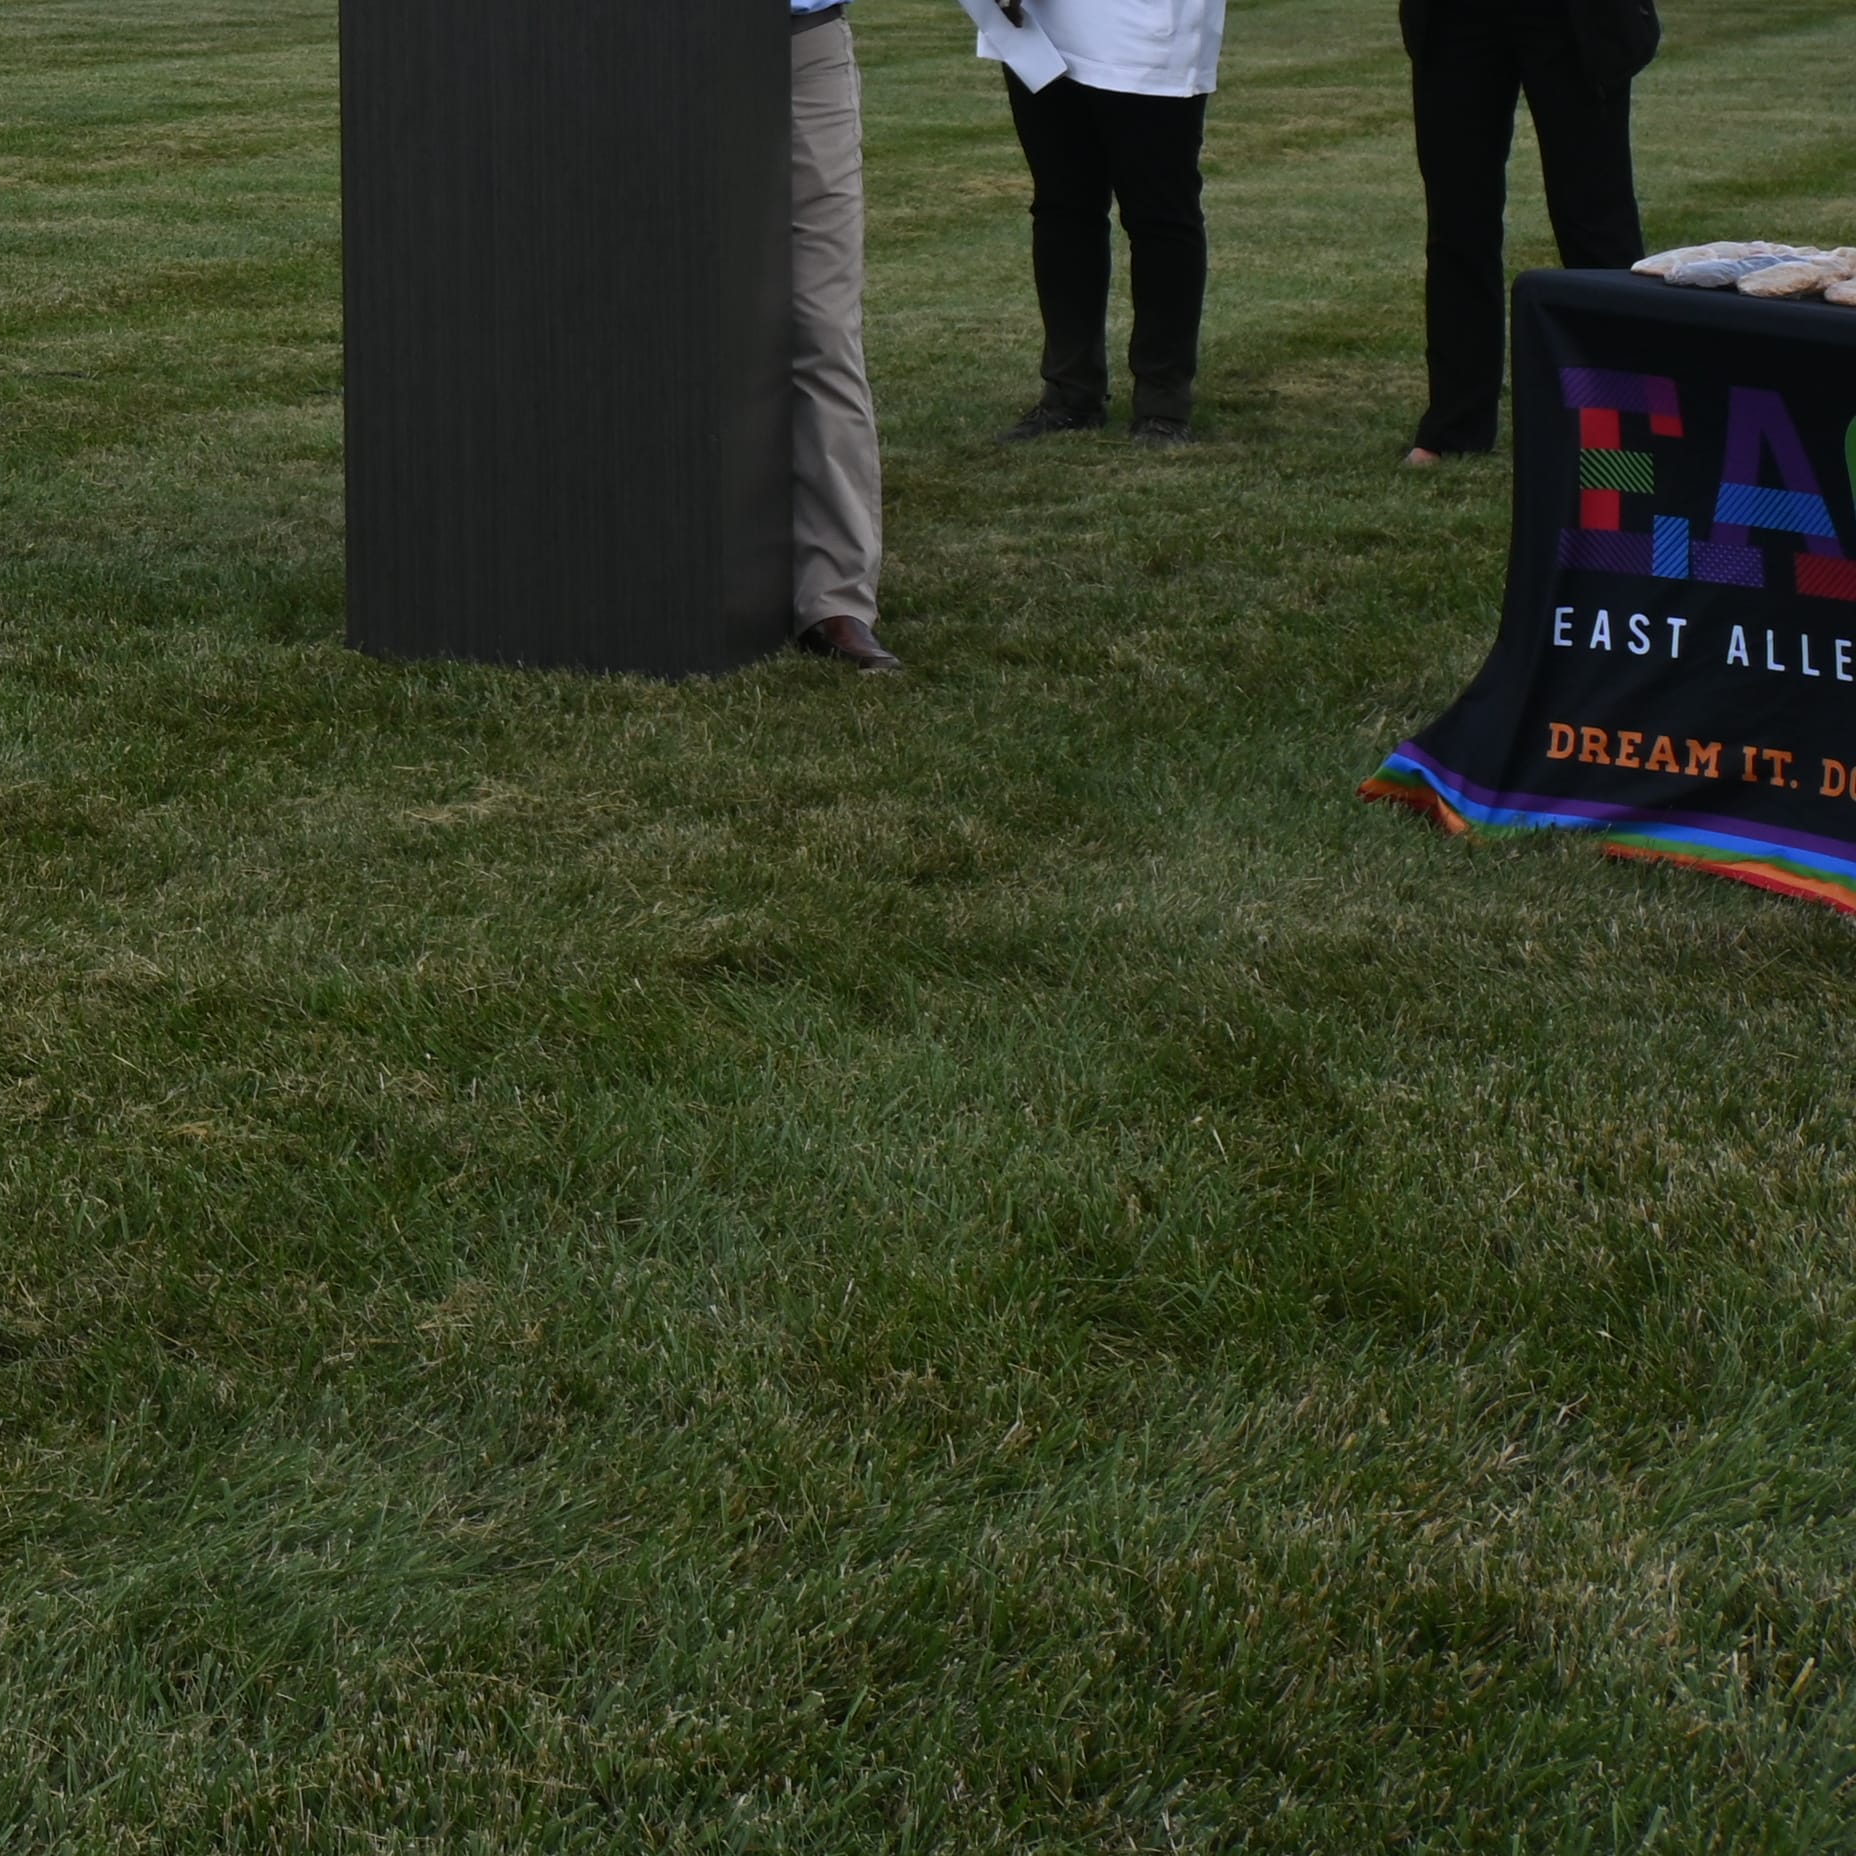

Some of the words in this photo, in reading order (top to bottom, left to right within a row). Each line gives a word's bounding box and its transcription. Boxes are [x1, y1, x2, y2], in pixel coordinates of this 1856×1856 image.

[1559, 366, 1856, 602] EA
[1553, 606, 1687, 659] EAST
[1546, 721, 1722, 778] DREAM
[1742, 746, 1800, 790] IT.
